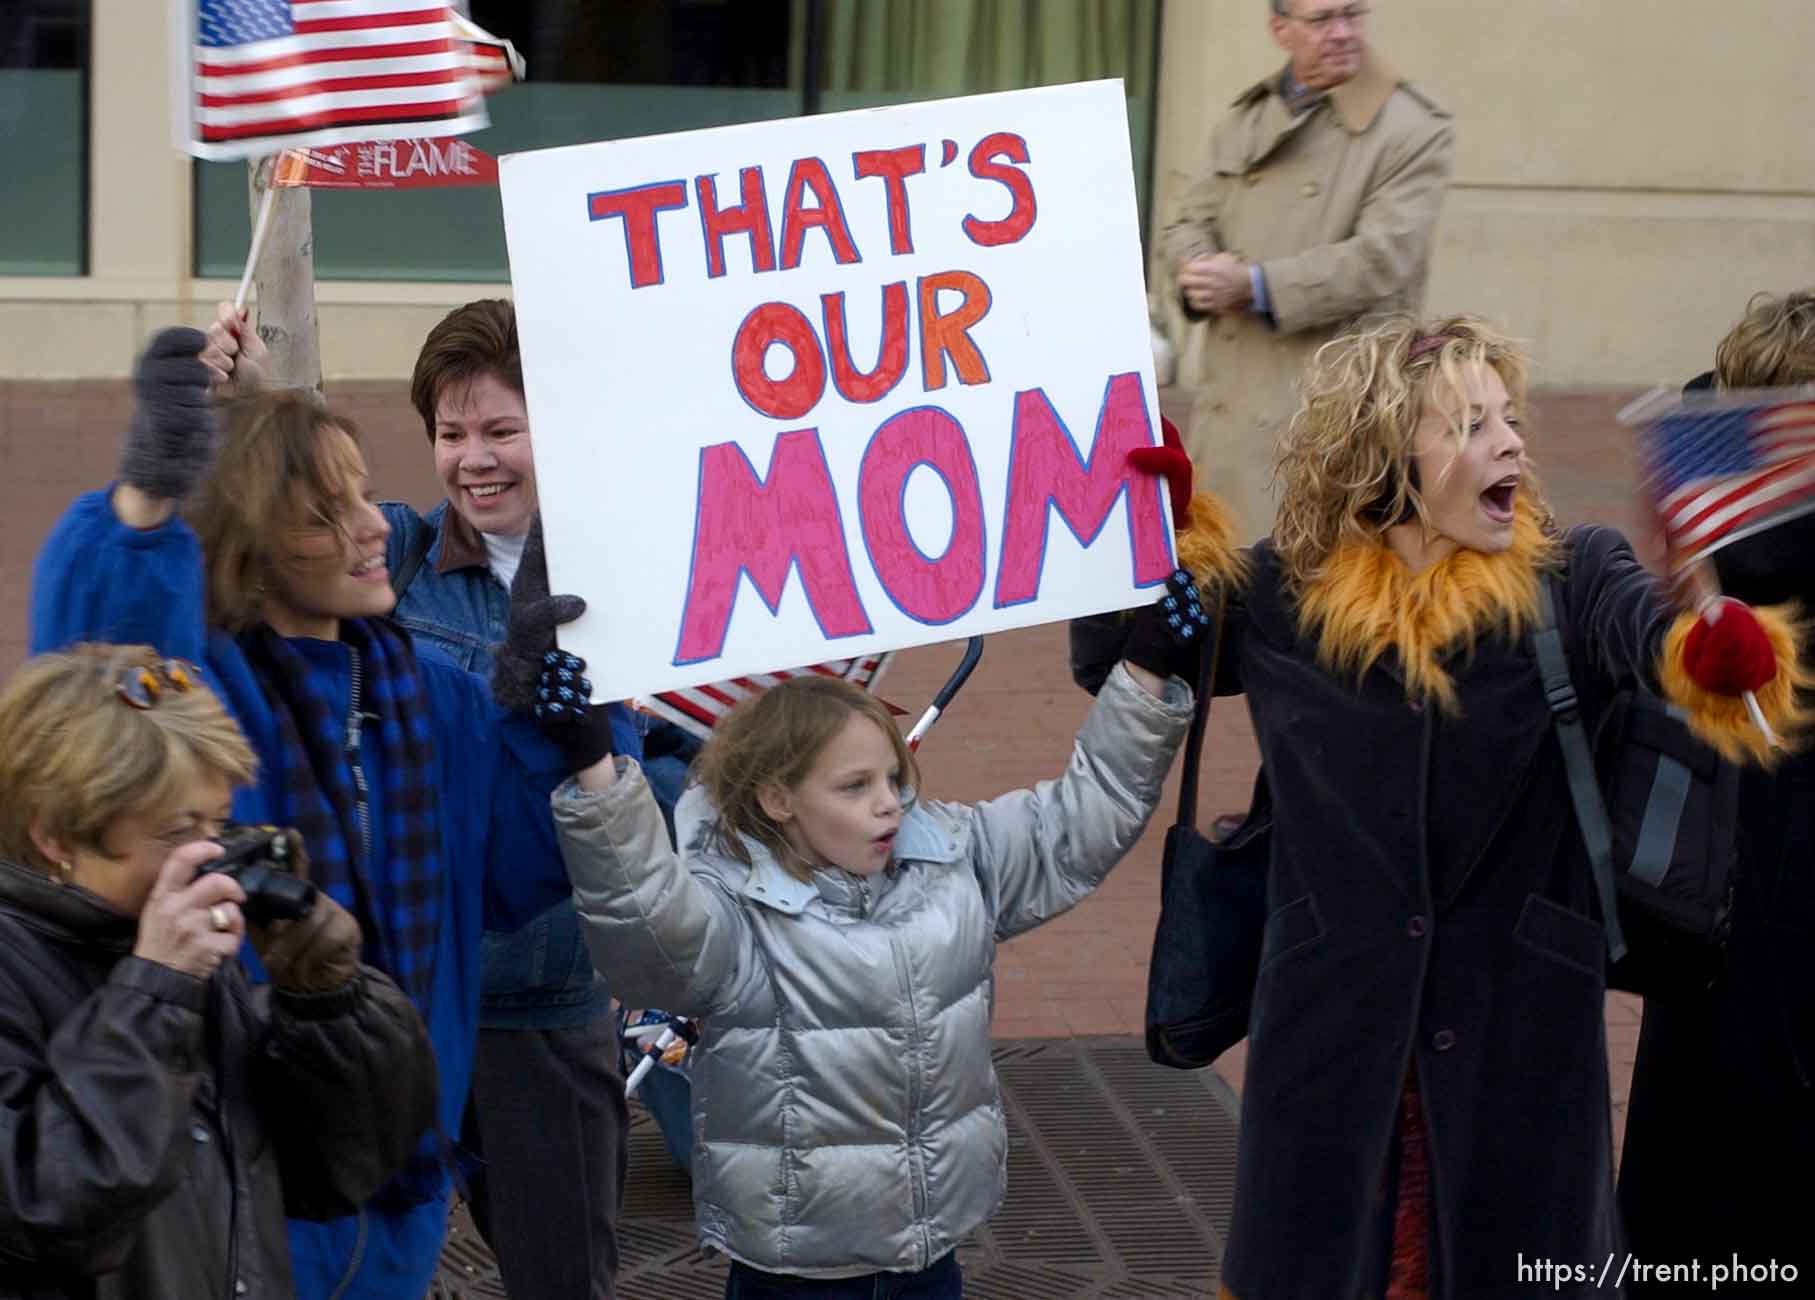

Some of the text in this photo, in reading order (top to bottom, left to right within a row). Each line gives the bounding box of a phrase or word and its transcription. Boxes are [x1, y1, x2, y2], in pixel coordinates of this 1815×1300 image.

[374, 139, 479, 177] FLAME
[588, 132, 1036, 289] THAT'S
[733, 271, 991, 420] OUR
[672, 372, 1176, 667] MOM
